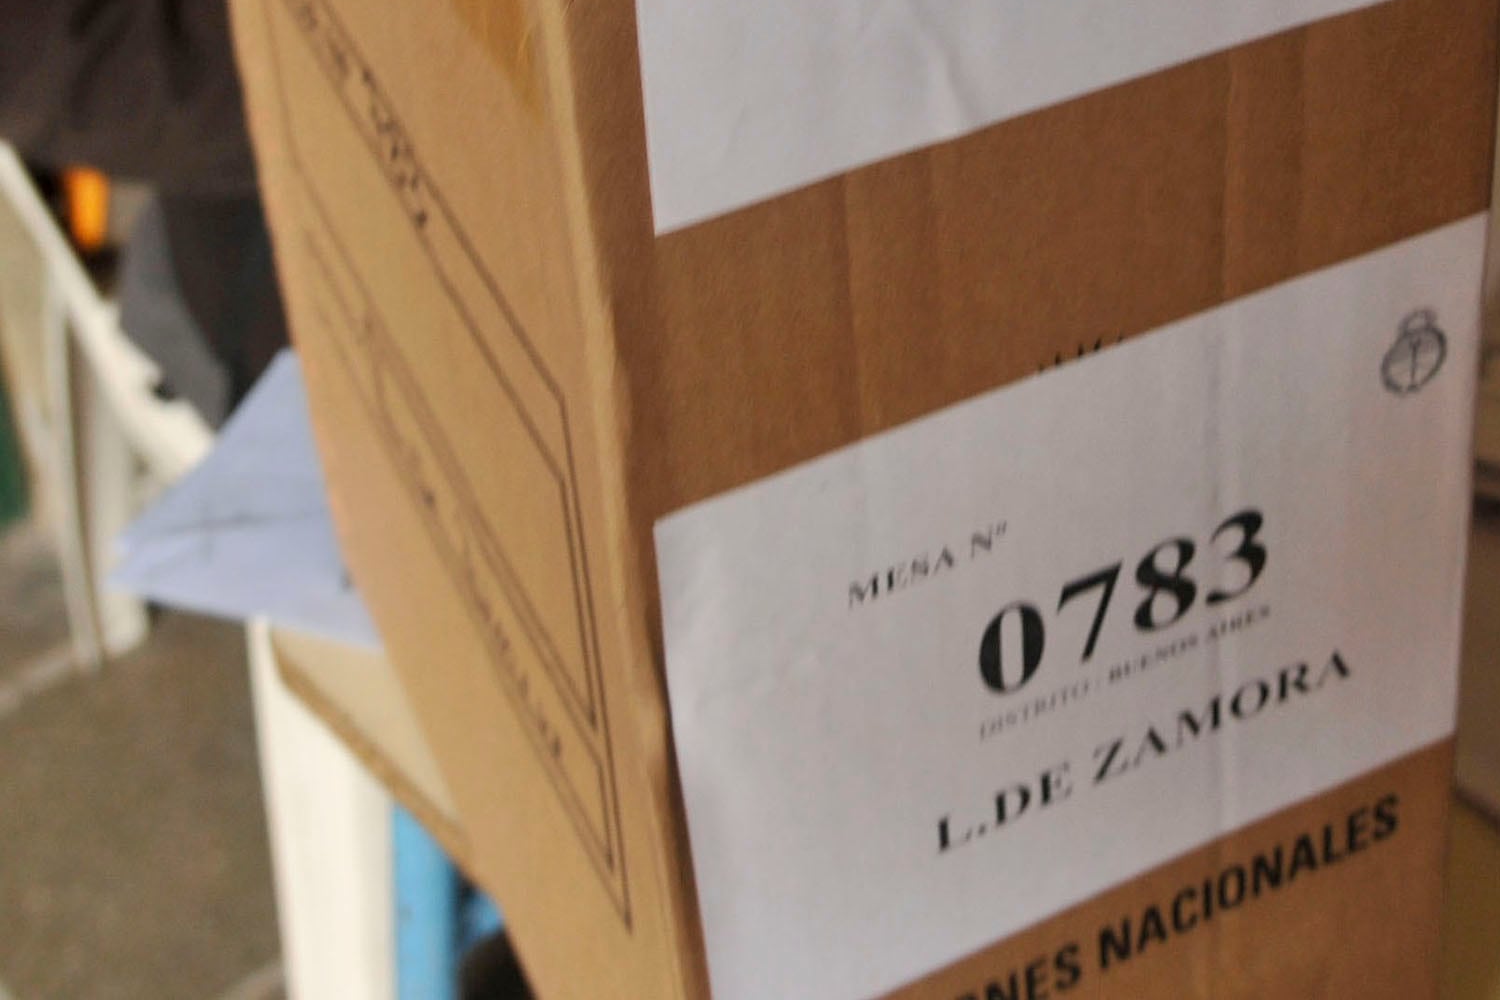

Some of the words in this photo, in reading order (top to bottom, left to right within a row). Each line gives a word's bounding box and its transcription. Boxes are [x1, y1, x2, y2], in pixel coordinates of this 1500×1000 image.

[848, 545, 955, 611] MESA
[978, 509, 1270, 698] 0783
[1093, 648, 1353, 786] ZAMORA
[1097, 794, 1398, 972] NACIONALES
